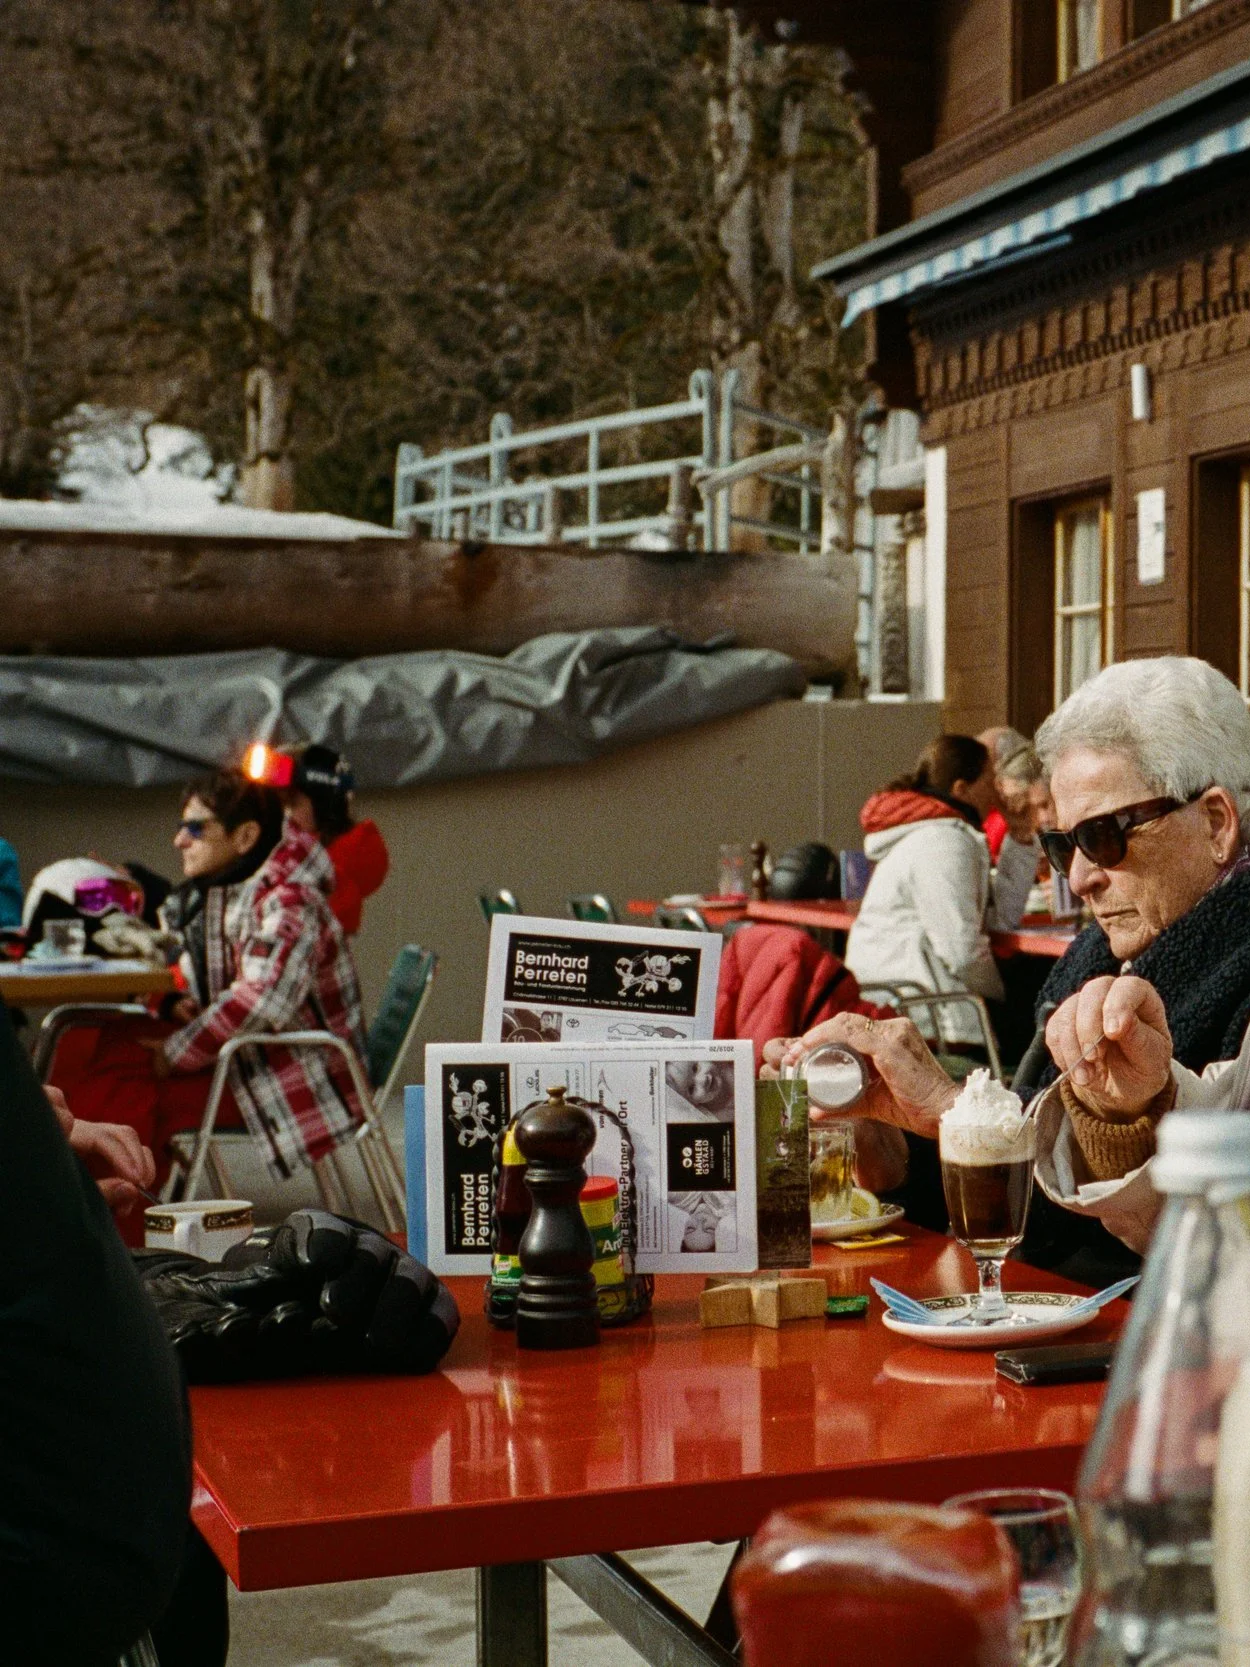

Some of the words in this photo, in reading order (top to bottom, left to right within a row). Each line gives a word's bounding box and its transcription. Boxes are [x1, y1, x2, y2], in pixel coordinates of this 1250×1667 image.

[514, 965, 588, 984] Perreten
[516, 949, 589, 970] Bernhard
[618, 1100, 628, 1119] Ort
[694, 1139, 703, 1175] HÄHLEN
[702, 1139, 710, 1175] GSTAAD
[461, 1174, 475, 1246] Bernhard
[476, 1174, 490, 1246] Perreten
